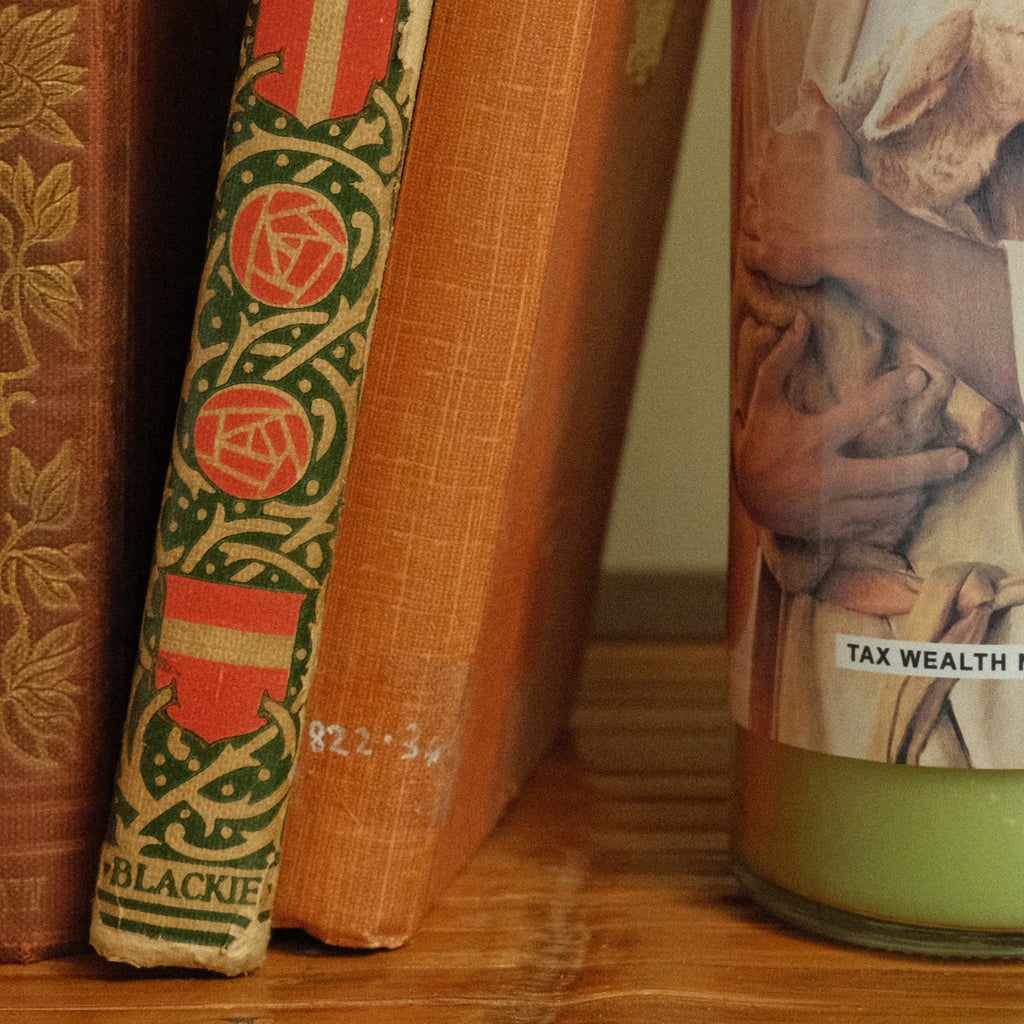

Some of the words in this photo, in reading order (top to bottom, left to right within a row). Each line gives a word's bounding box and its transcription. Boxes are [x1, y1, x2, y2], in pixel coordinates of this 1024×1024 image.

[847, 643, 890, 666] TAX
[900, 649, 1006, 671] WEALTH
[109, 856, 265, 906] BLACKIE
